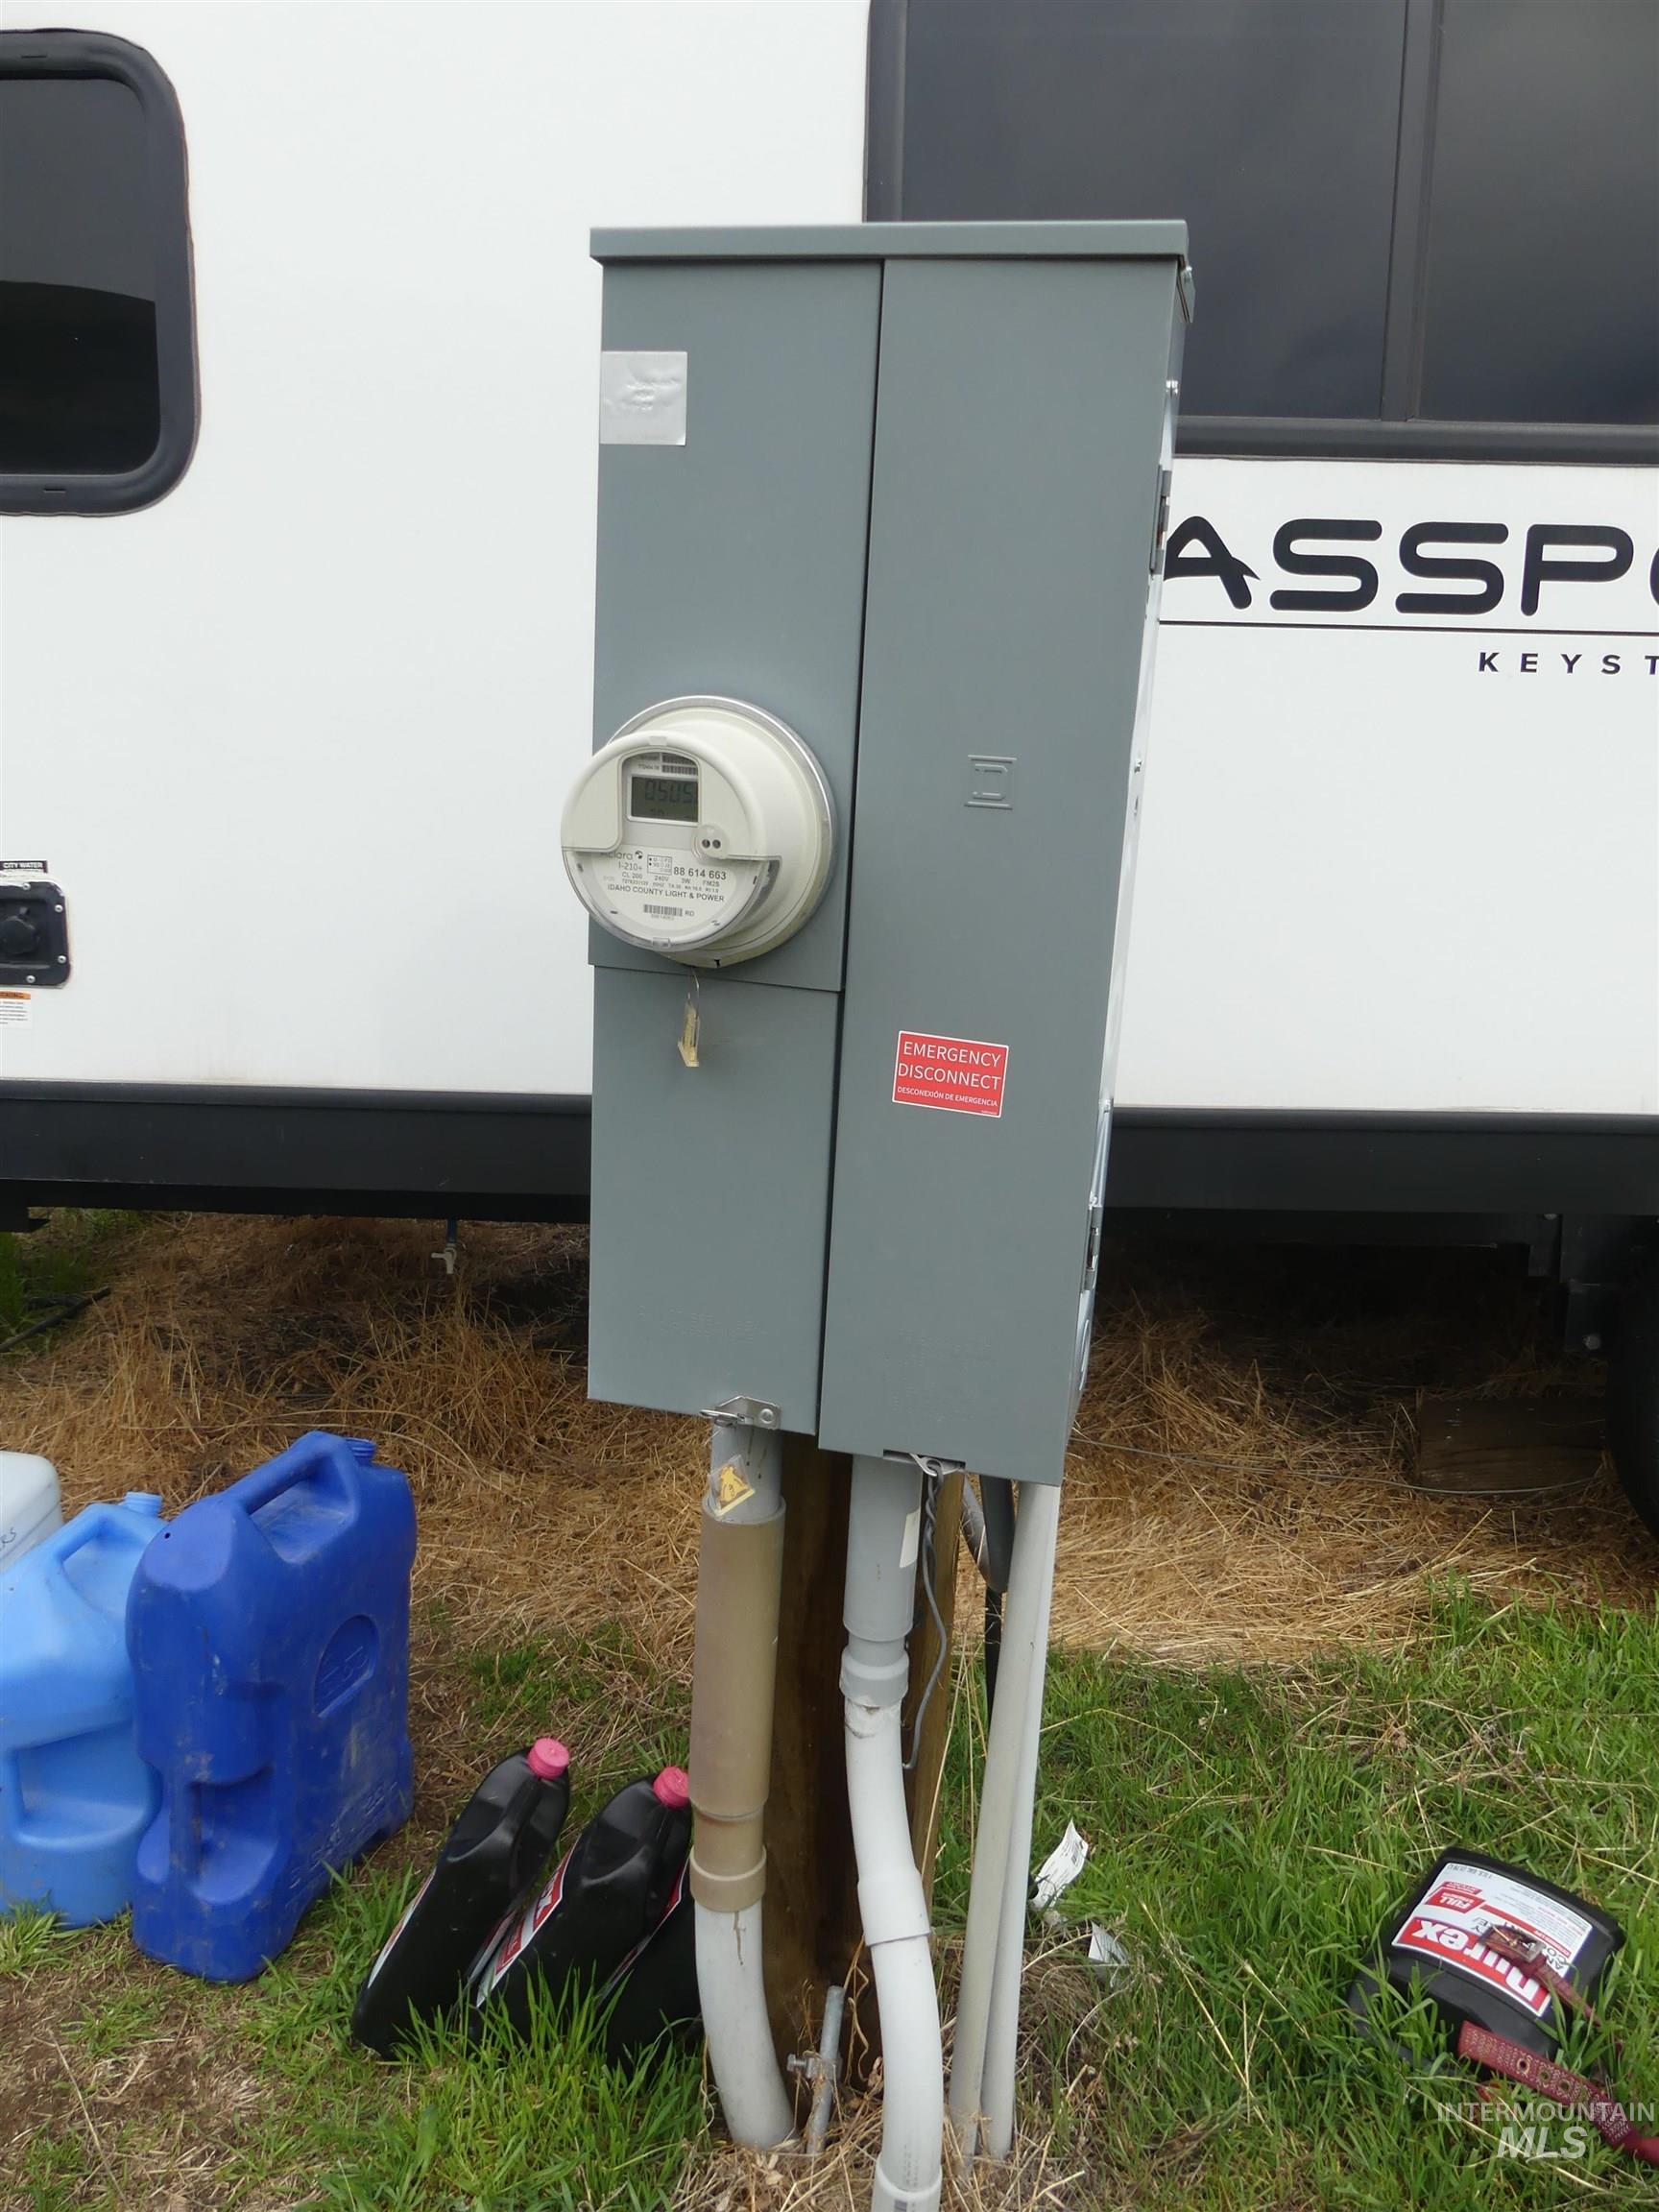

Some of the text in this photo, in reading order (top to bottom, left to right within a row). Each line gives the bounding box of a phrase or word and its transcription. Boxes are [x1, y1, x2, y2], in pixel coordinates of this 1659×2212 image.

[1164, 516, 1659, 615] ASSP
[1479, 652, 1659, 675] KEYST
[673, 866, 727, 880] 88 614 663
[608, 883, 632, 892] IDAHO
[633, 885, 663, 896] COUNTY
[665, 890, 687, 899] LIGHT
[696, 892, 725, 902] POWER
[903, 1041, 1000, 1068] EMERGENCY
[898, 1063, 1001, 1091] DISCONNECT
[897, 1086, 998, 1107] DESCONEXIÓN DE EMERGENCIA
[1439, 1894, 1471, 1910] FULL
